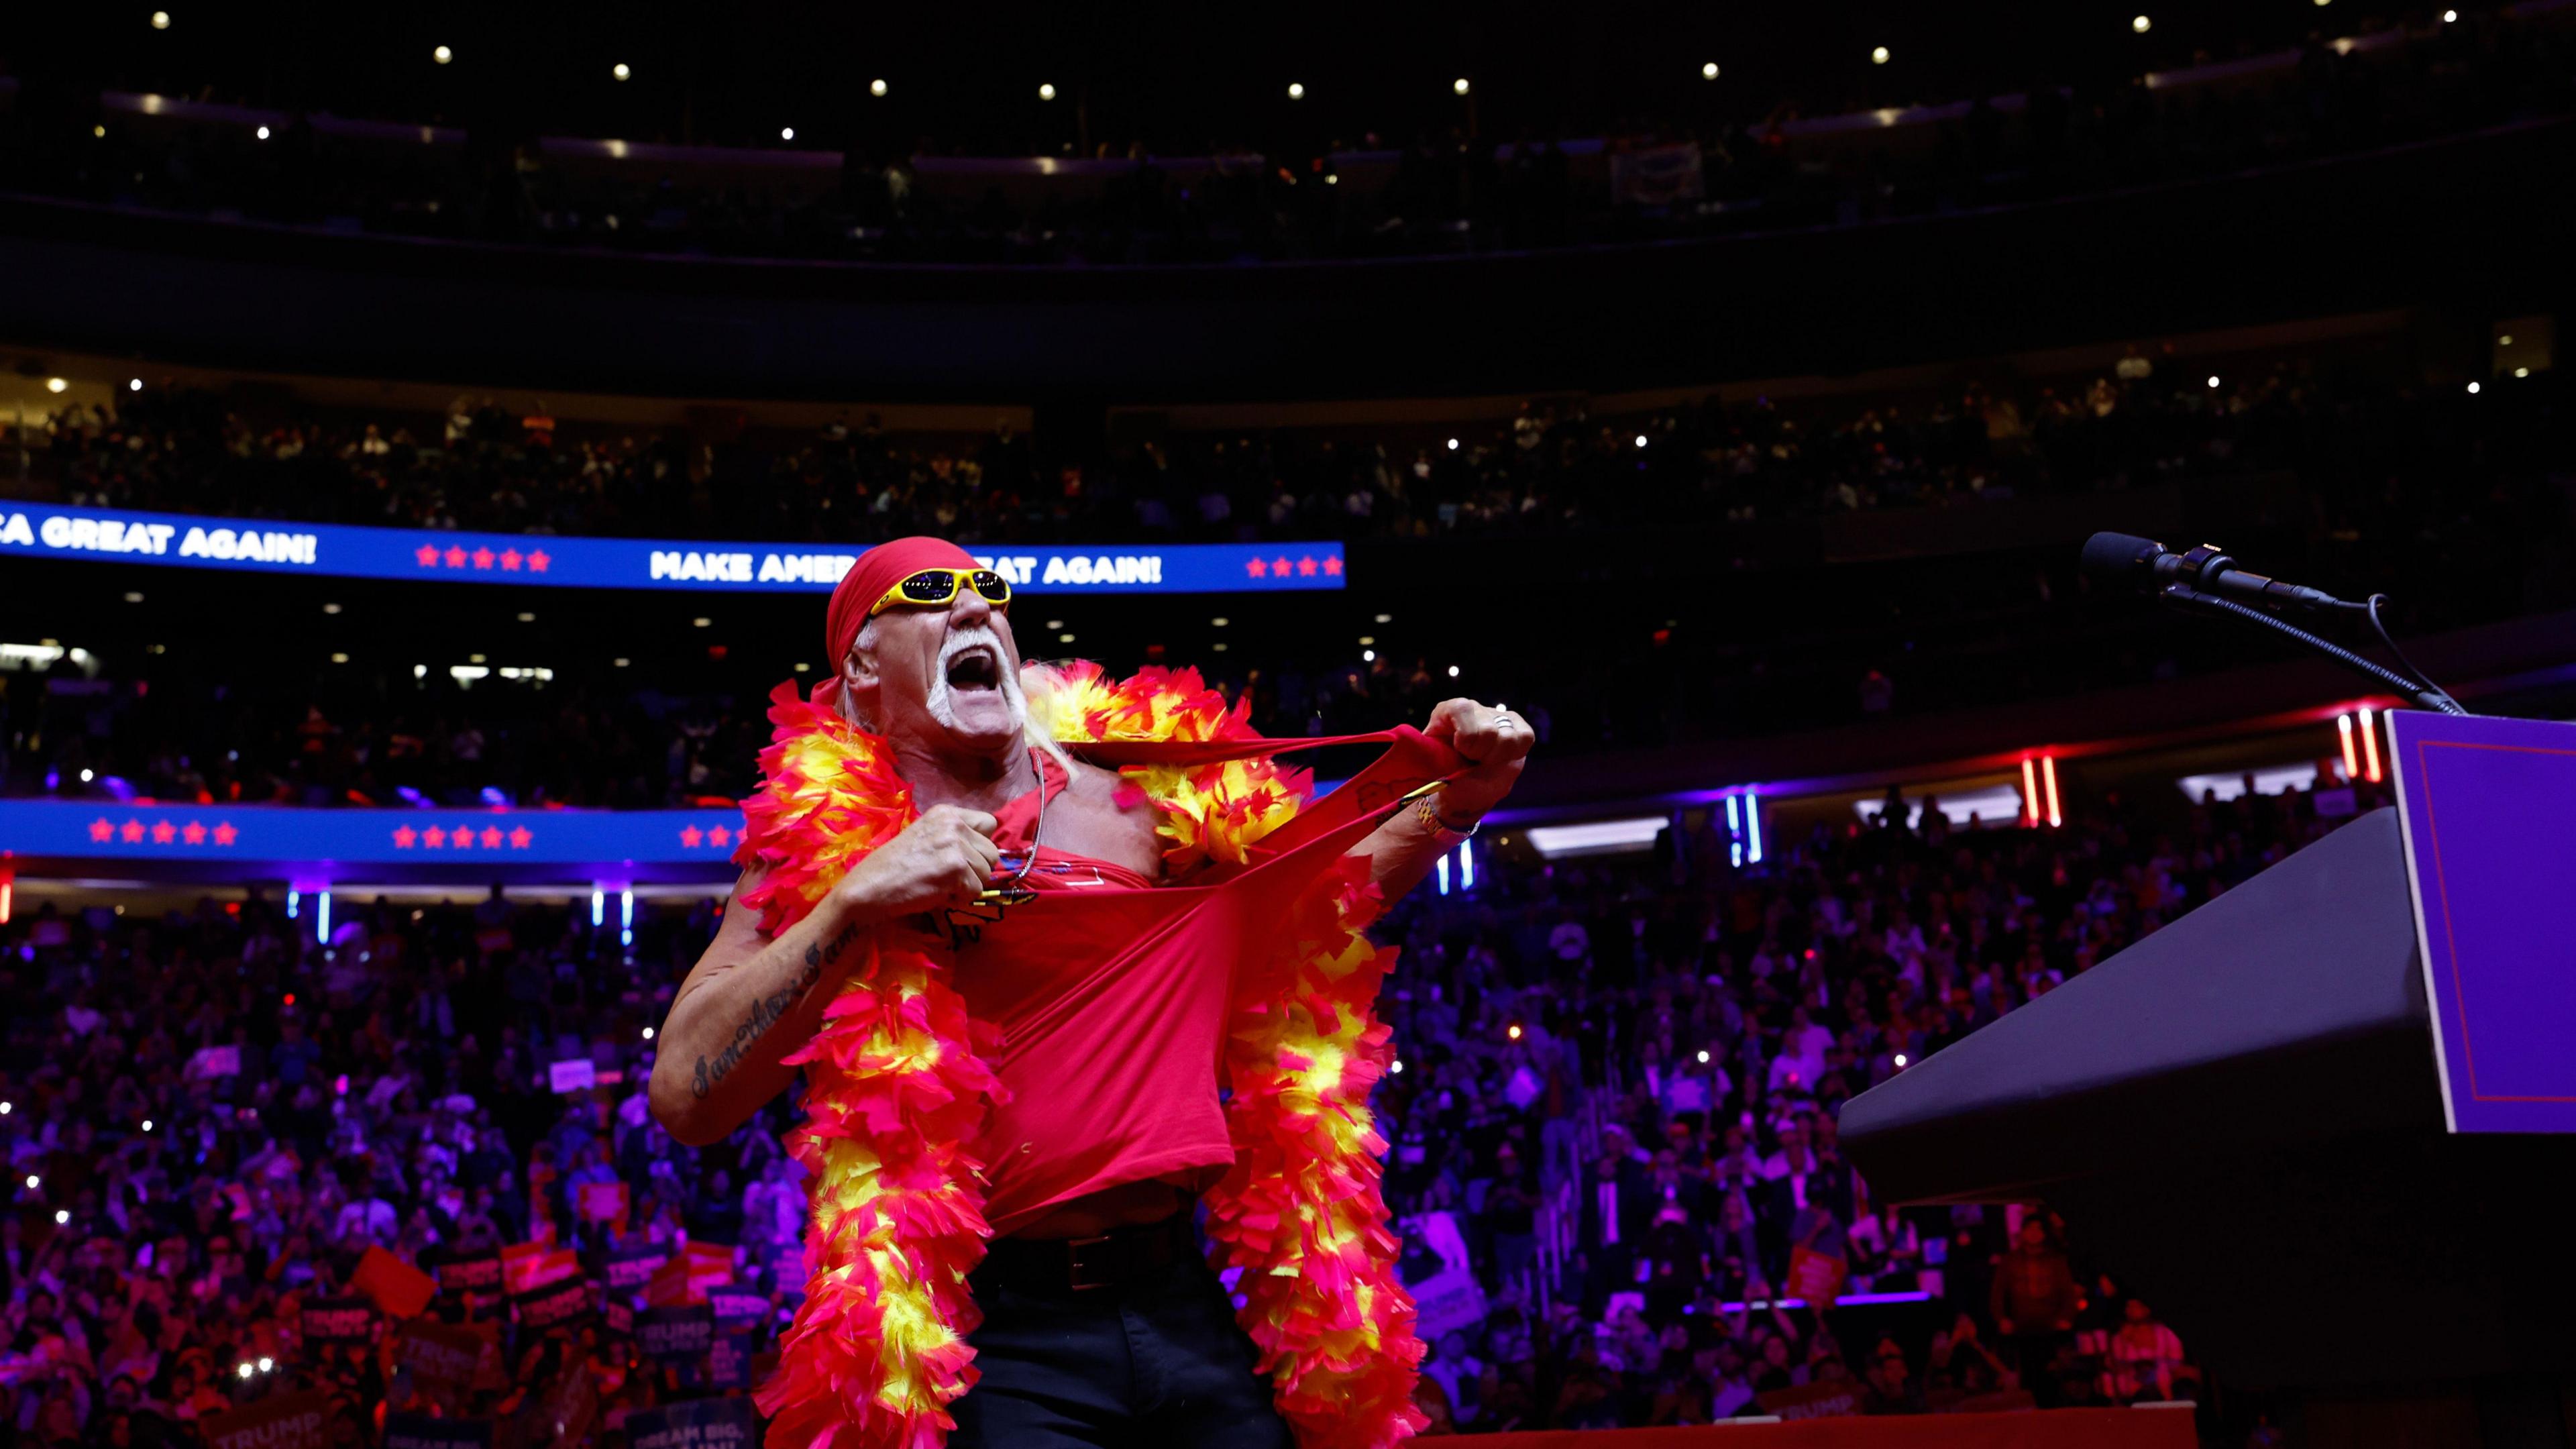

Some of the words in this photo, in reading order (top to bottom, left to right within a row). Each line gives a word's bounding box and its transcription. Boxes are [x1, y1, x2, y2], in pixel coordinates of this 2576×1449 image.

[40, 515, 176, 555] GREAT
[178, 527, 318, 566] AGAIN!
[650, 550, 753, 582] MAKE
[1041, 555, 1163, 585] AGAIN!
[215, 1411, 322, 1449] TRUMP
